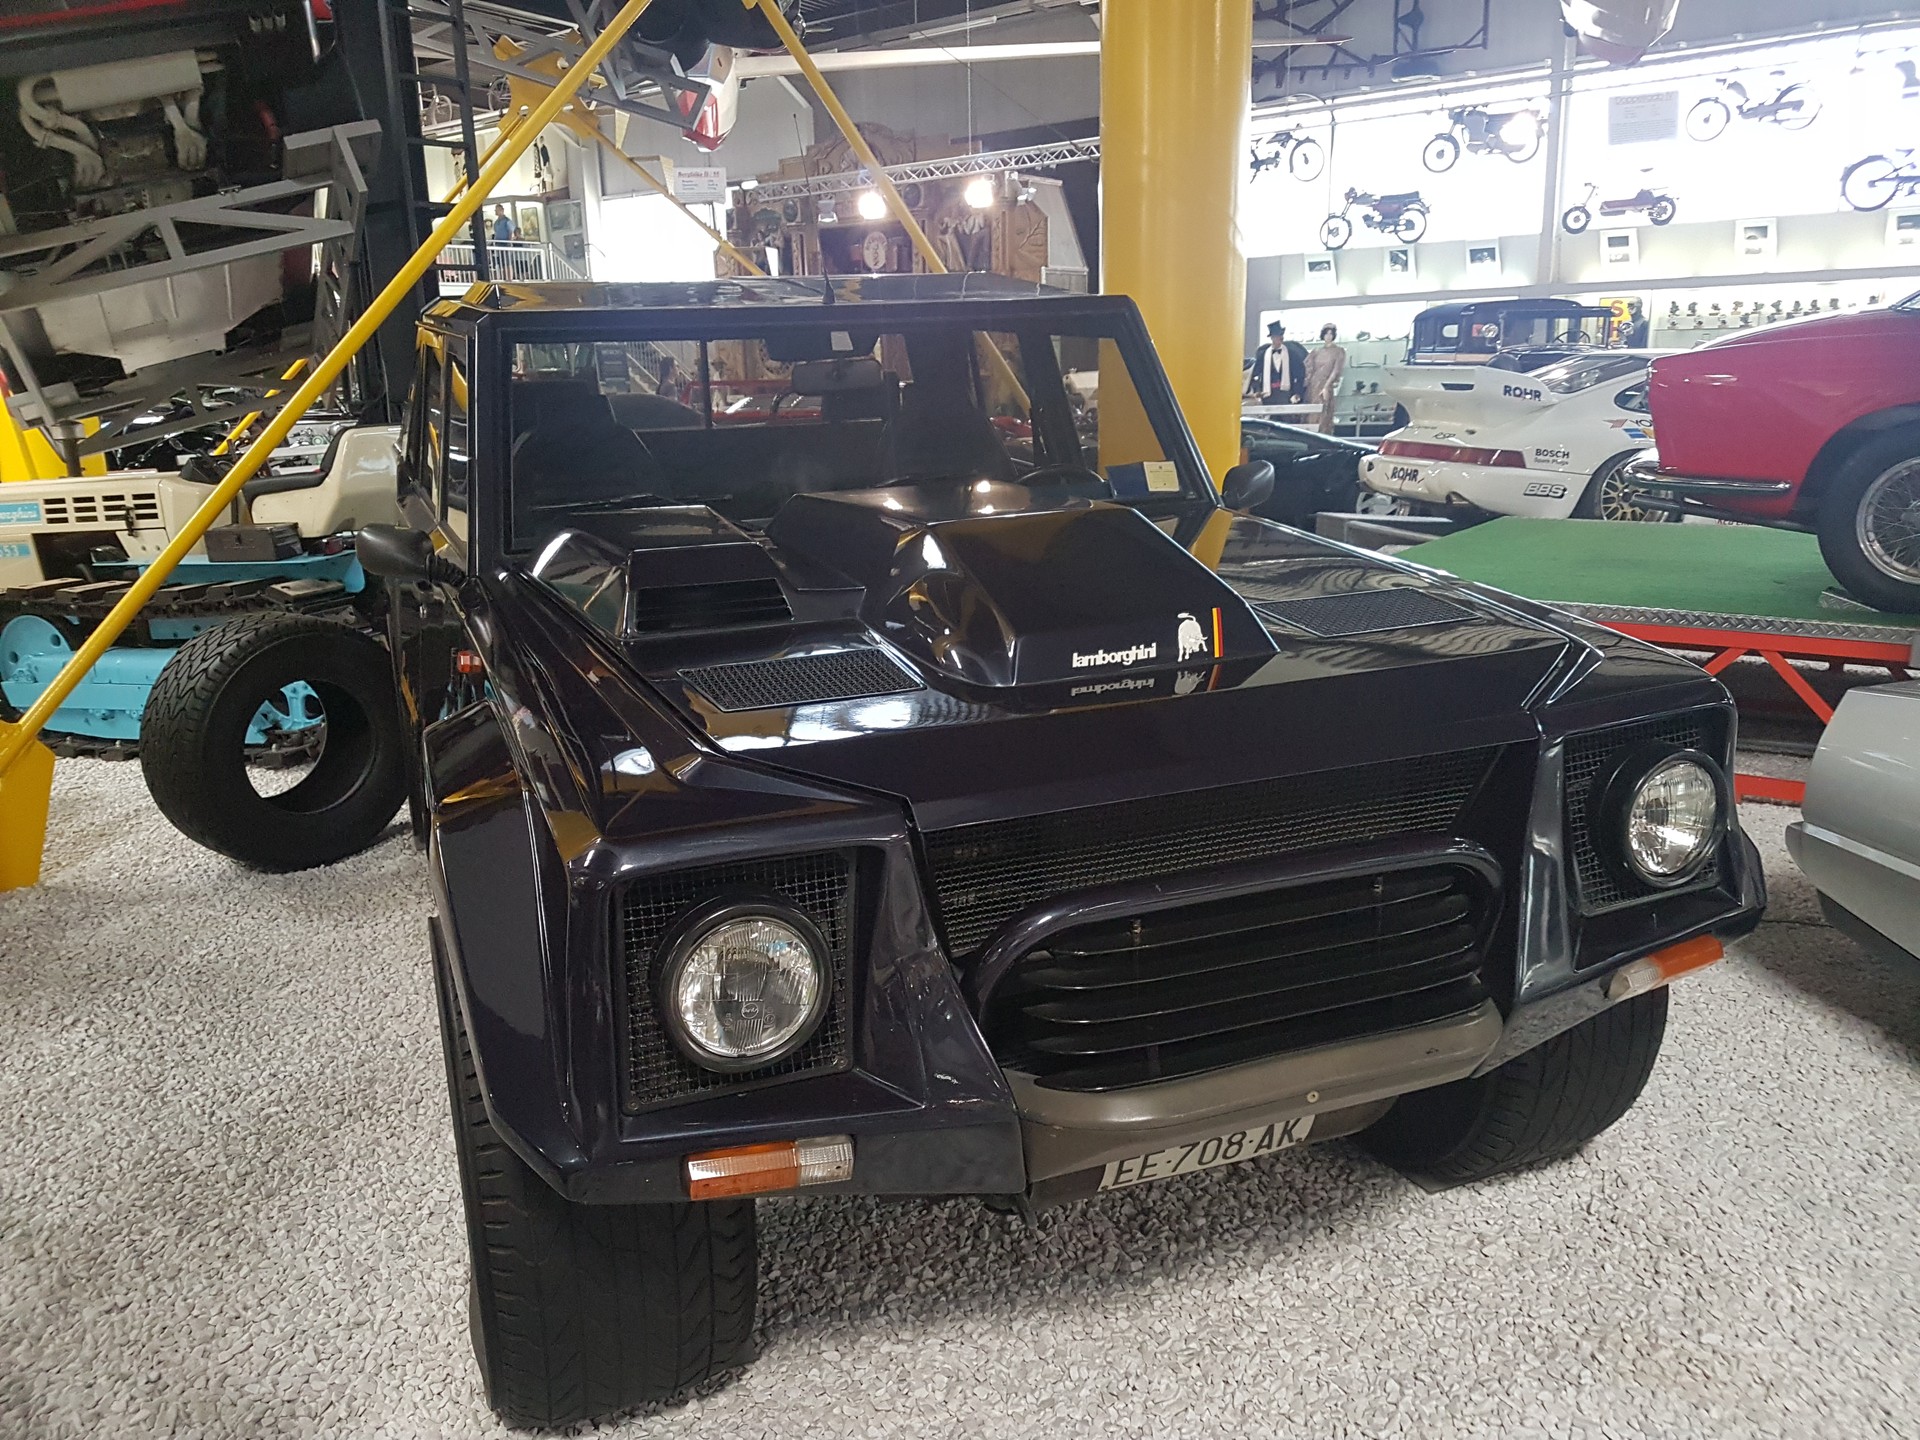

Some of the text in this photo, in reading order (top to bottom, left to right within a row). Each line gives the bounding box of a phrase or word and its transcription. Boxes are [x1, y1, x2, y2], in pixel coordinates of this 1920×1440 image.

[1503, 385, 1542, 401] ROHR
[1629, 419, 1654, 427] YO
[1535, 448, 1570, 459] BOSCH
[1390, 466, 1419, 482] ROHR
[1523, 483, 1565, 499] BBS
[1072, 642, 1157, 668] lamborghini
